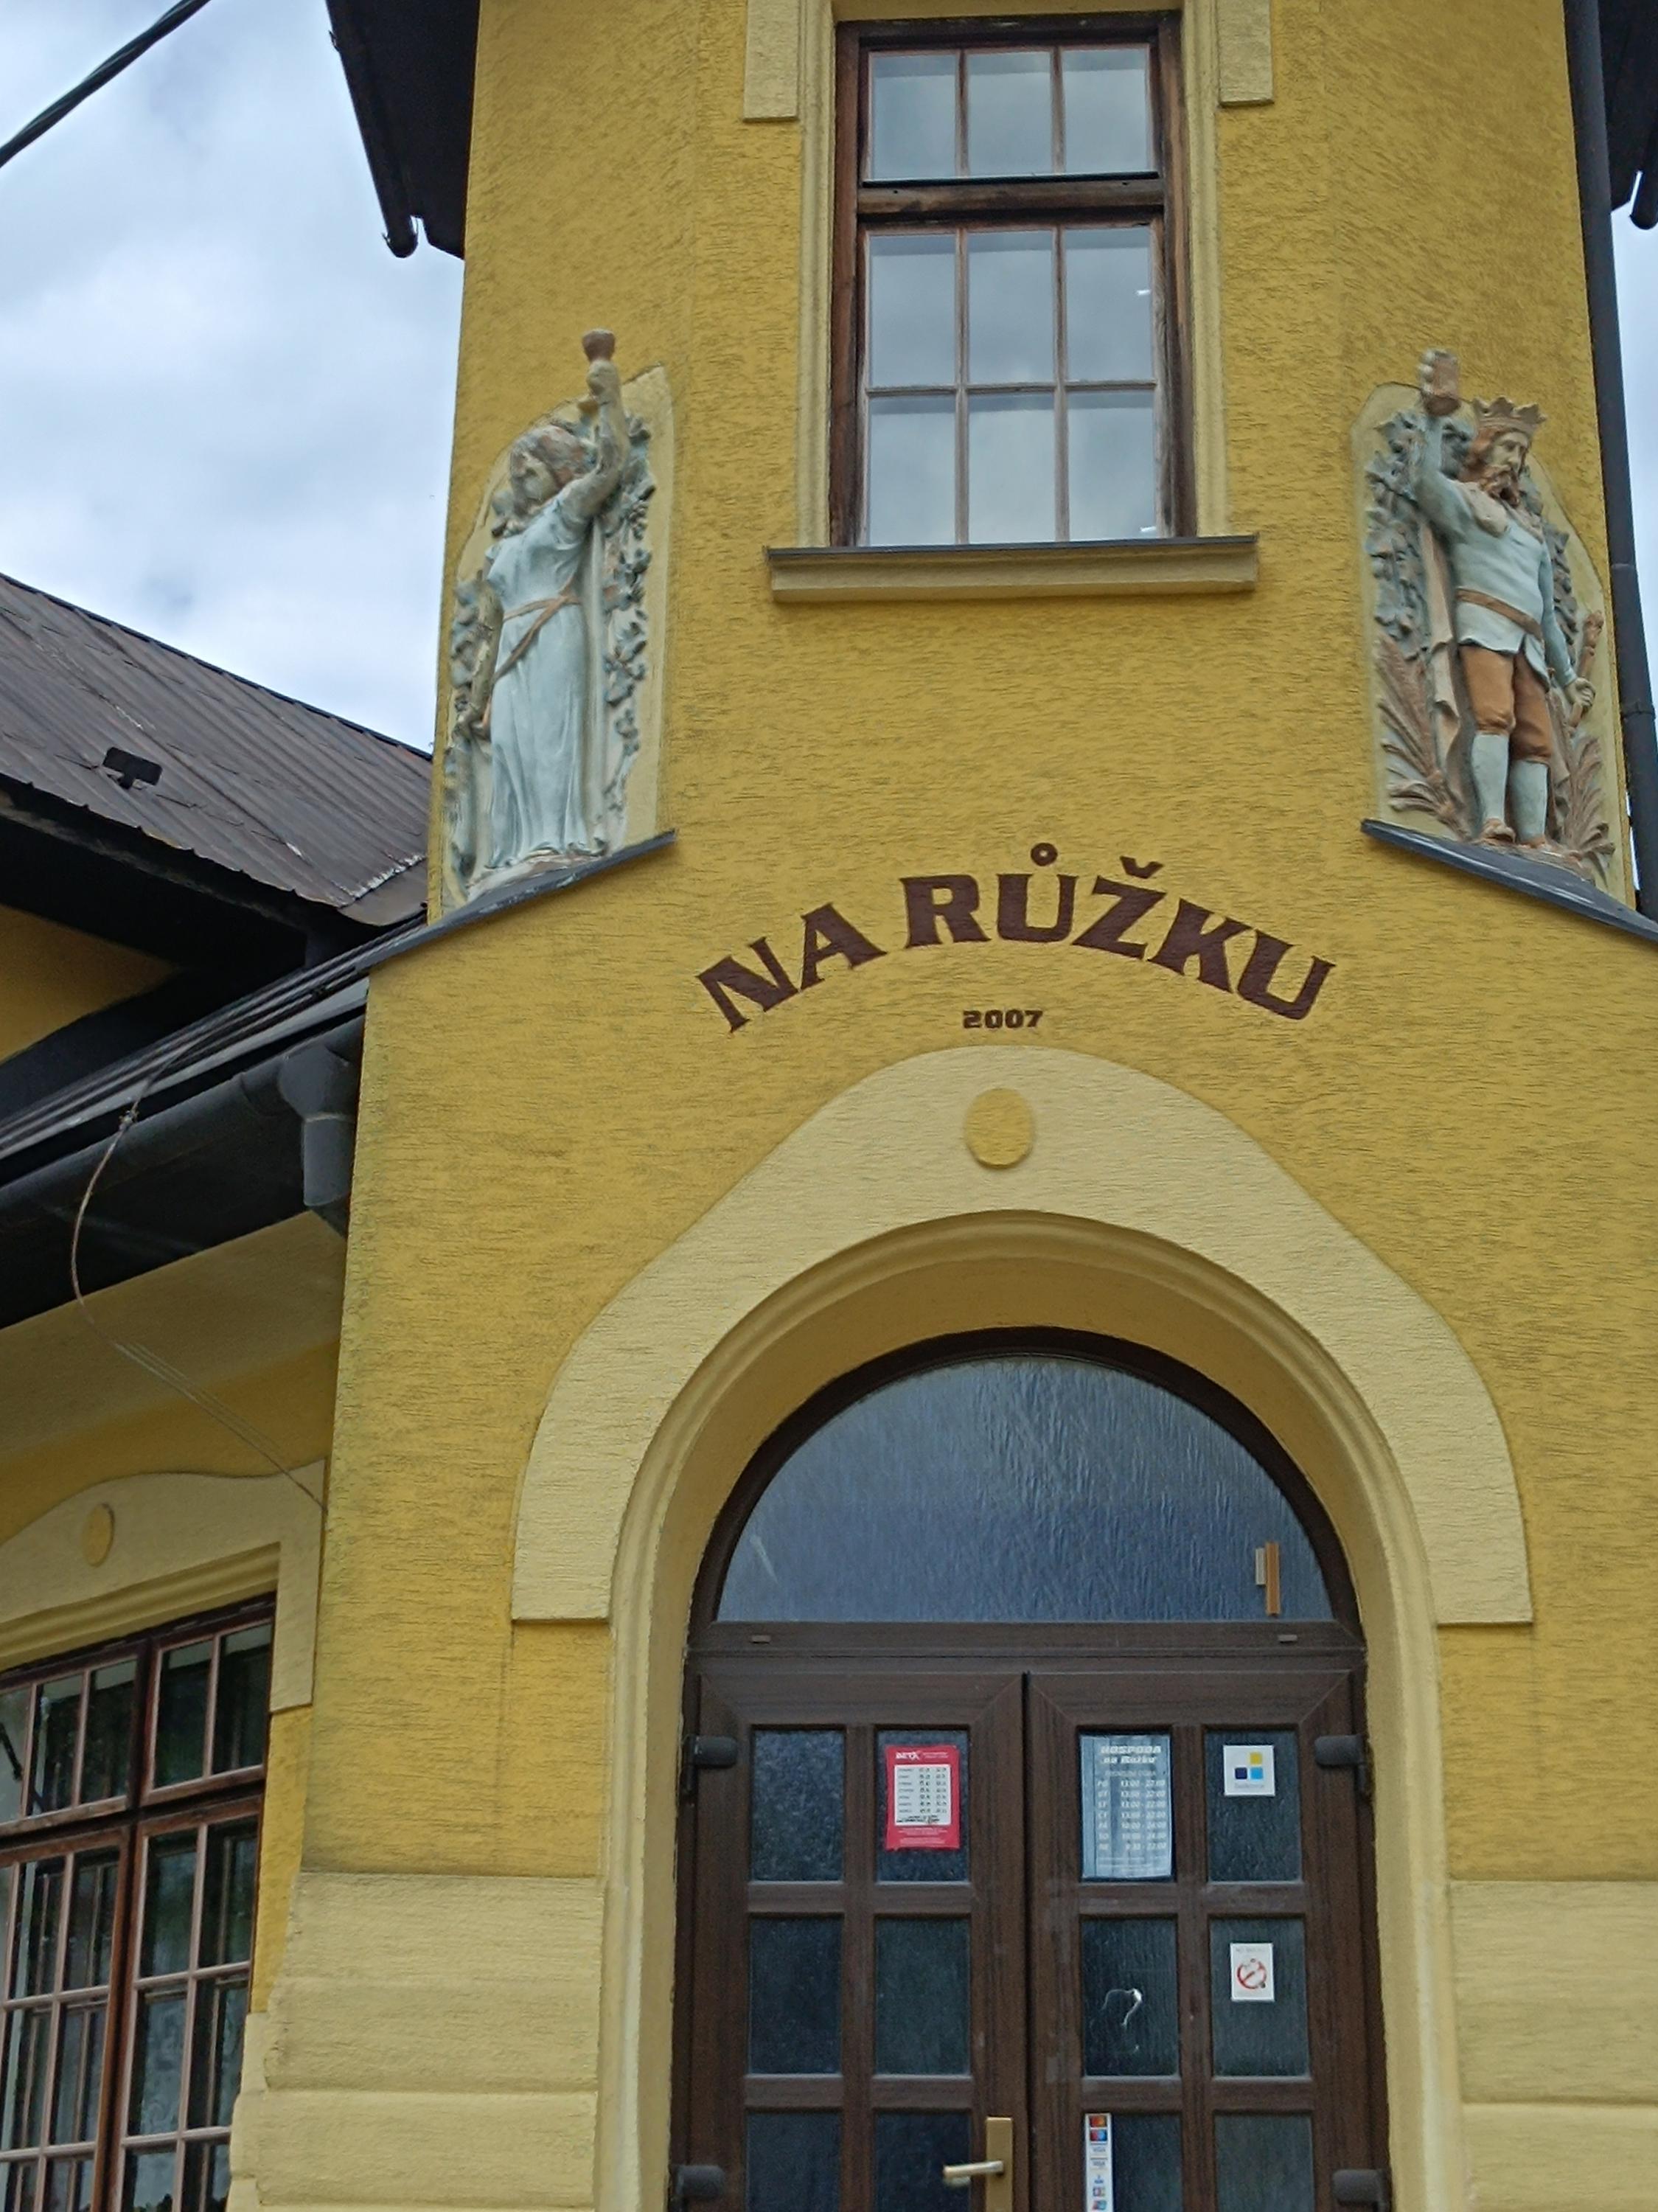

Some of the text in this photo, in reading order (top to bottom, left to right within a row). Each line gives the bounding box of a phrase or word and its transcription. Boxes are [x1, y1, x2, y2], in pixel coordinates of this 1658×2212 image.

[696, 841, 1337, 1034] NA RŮŽKU
[962, 1009, 1044, 1030] 2007
